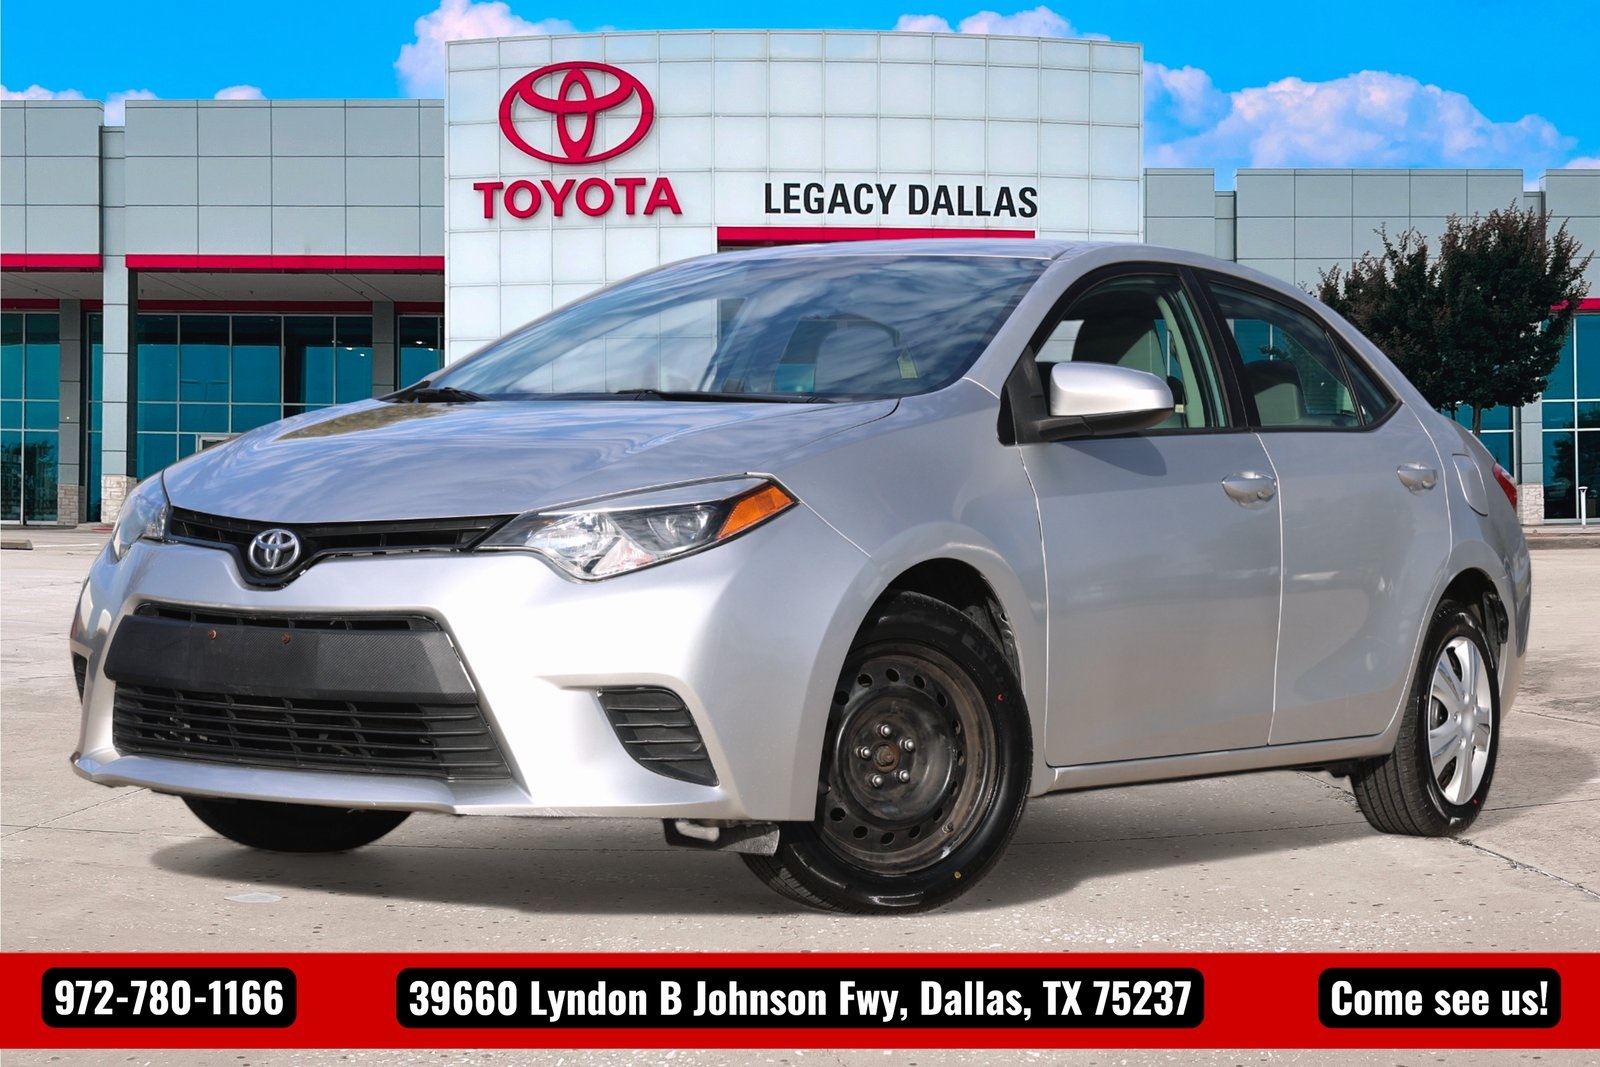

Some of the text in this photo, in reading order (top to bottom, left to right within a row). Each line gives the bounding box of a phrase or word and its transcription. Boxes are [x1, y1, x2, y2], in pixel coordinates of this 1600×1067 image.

[473, 176, 682, 220] TOYOTA
[764, 182, 1038, 218] LEGACY DALLAS
